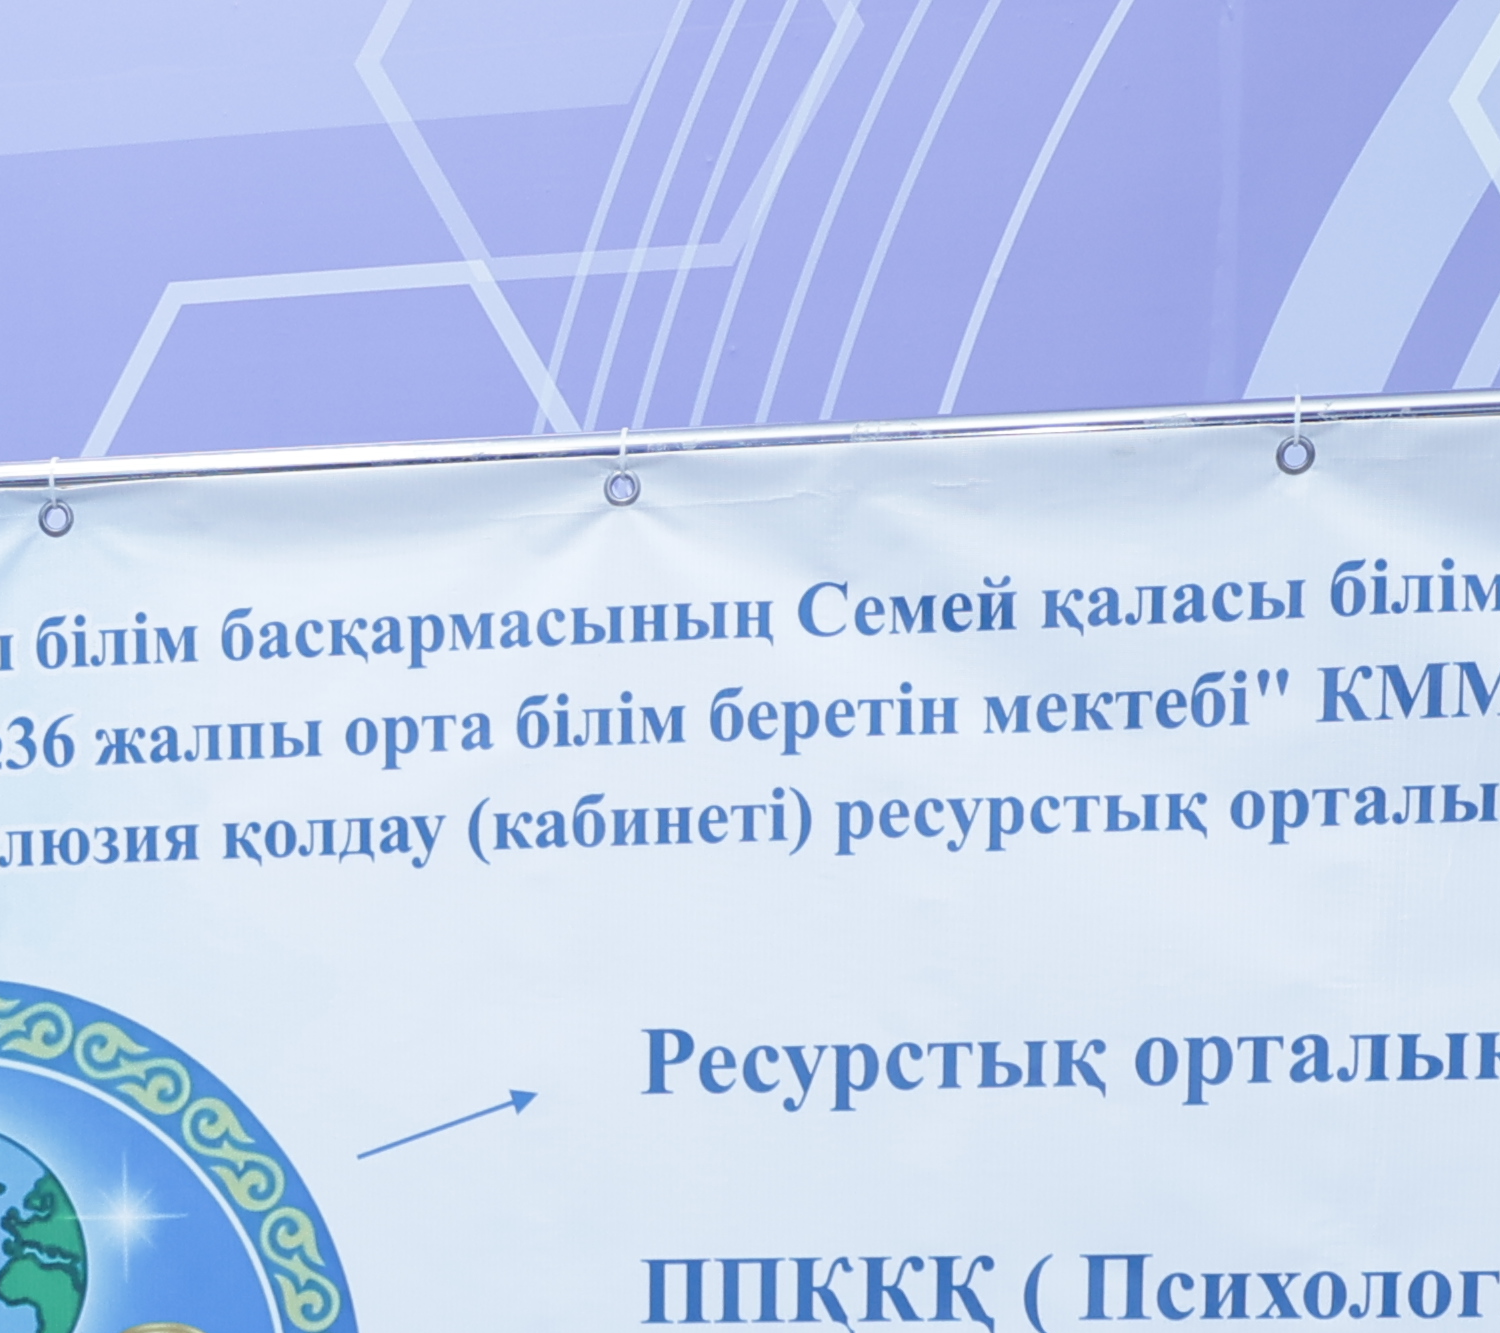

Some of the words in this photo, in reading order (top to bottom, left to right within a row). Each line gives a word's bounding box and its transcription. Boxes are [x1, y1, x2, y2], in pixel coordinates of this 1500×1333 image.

[36, 611, 198, 670] білім
[221, 600, 774, 670] басқармасының
[797, 575, 1017, 637] Семей
[1041, 579, 1305, 636] қаласы
[95, 720, 322, 766] жалпы
[345, 712, 494, 771] орта
[516, 690, 685, 749] білім
[709, 681, 958, 756] беретін
[984, 667, 1289, 734] мектебі"
[223, 815, 446, 869] қолдау
[468, 786, 812, 865] (кабинеті)
[835, 791, 1208, 856] ресурстық
[642, 1028, 1107, 1113] Ресурстық
